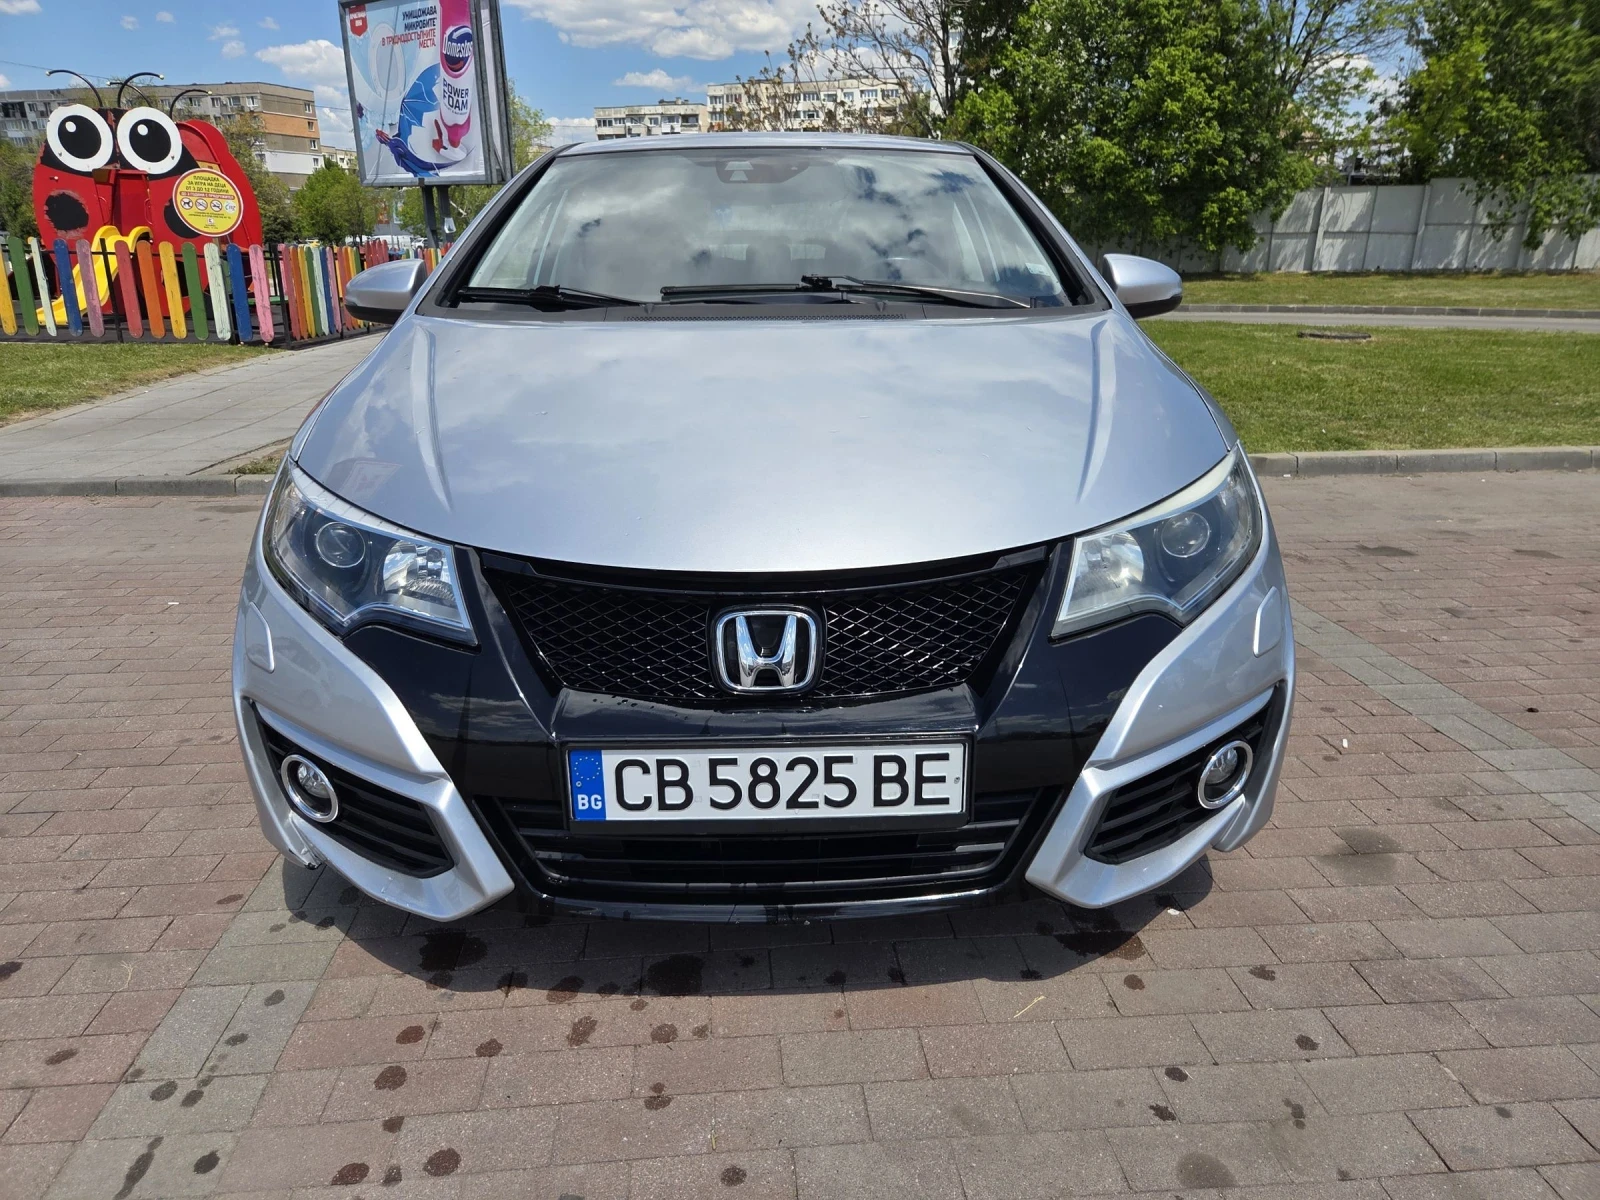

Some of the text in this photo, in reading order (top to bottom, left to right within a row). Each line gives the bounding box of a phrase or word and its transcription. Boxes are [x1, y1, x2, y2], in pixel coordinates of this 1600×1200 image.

[402, 5, 437, 21] УНИЩОЖАВА
[382, 37, 386, 46] В
[443, 77, 469, 98] POWER
[443, 88, 468, 111] FOAM
[614, 752, 951, 812] CB 5825 BE
[577, 794, 603, 810] BG
